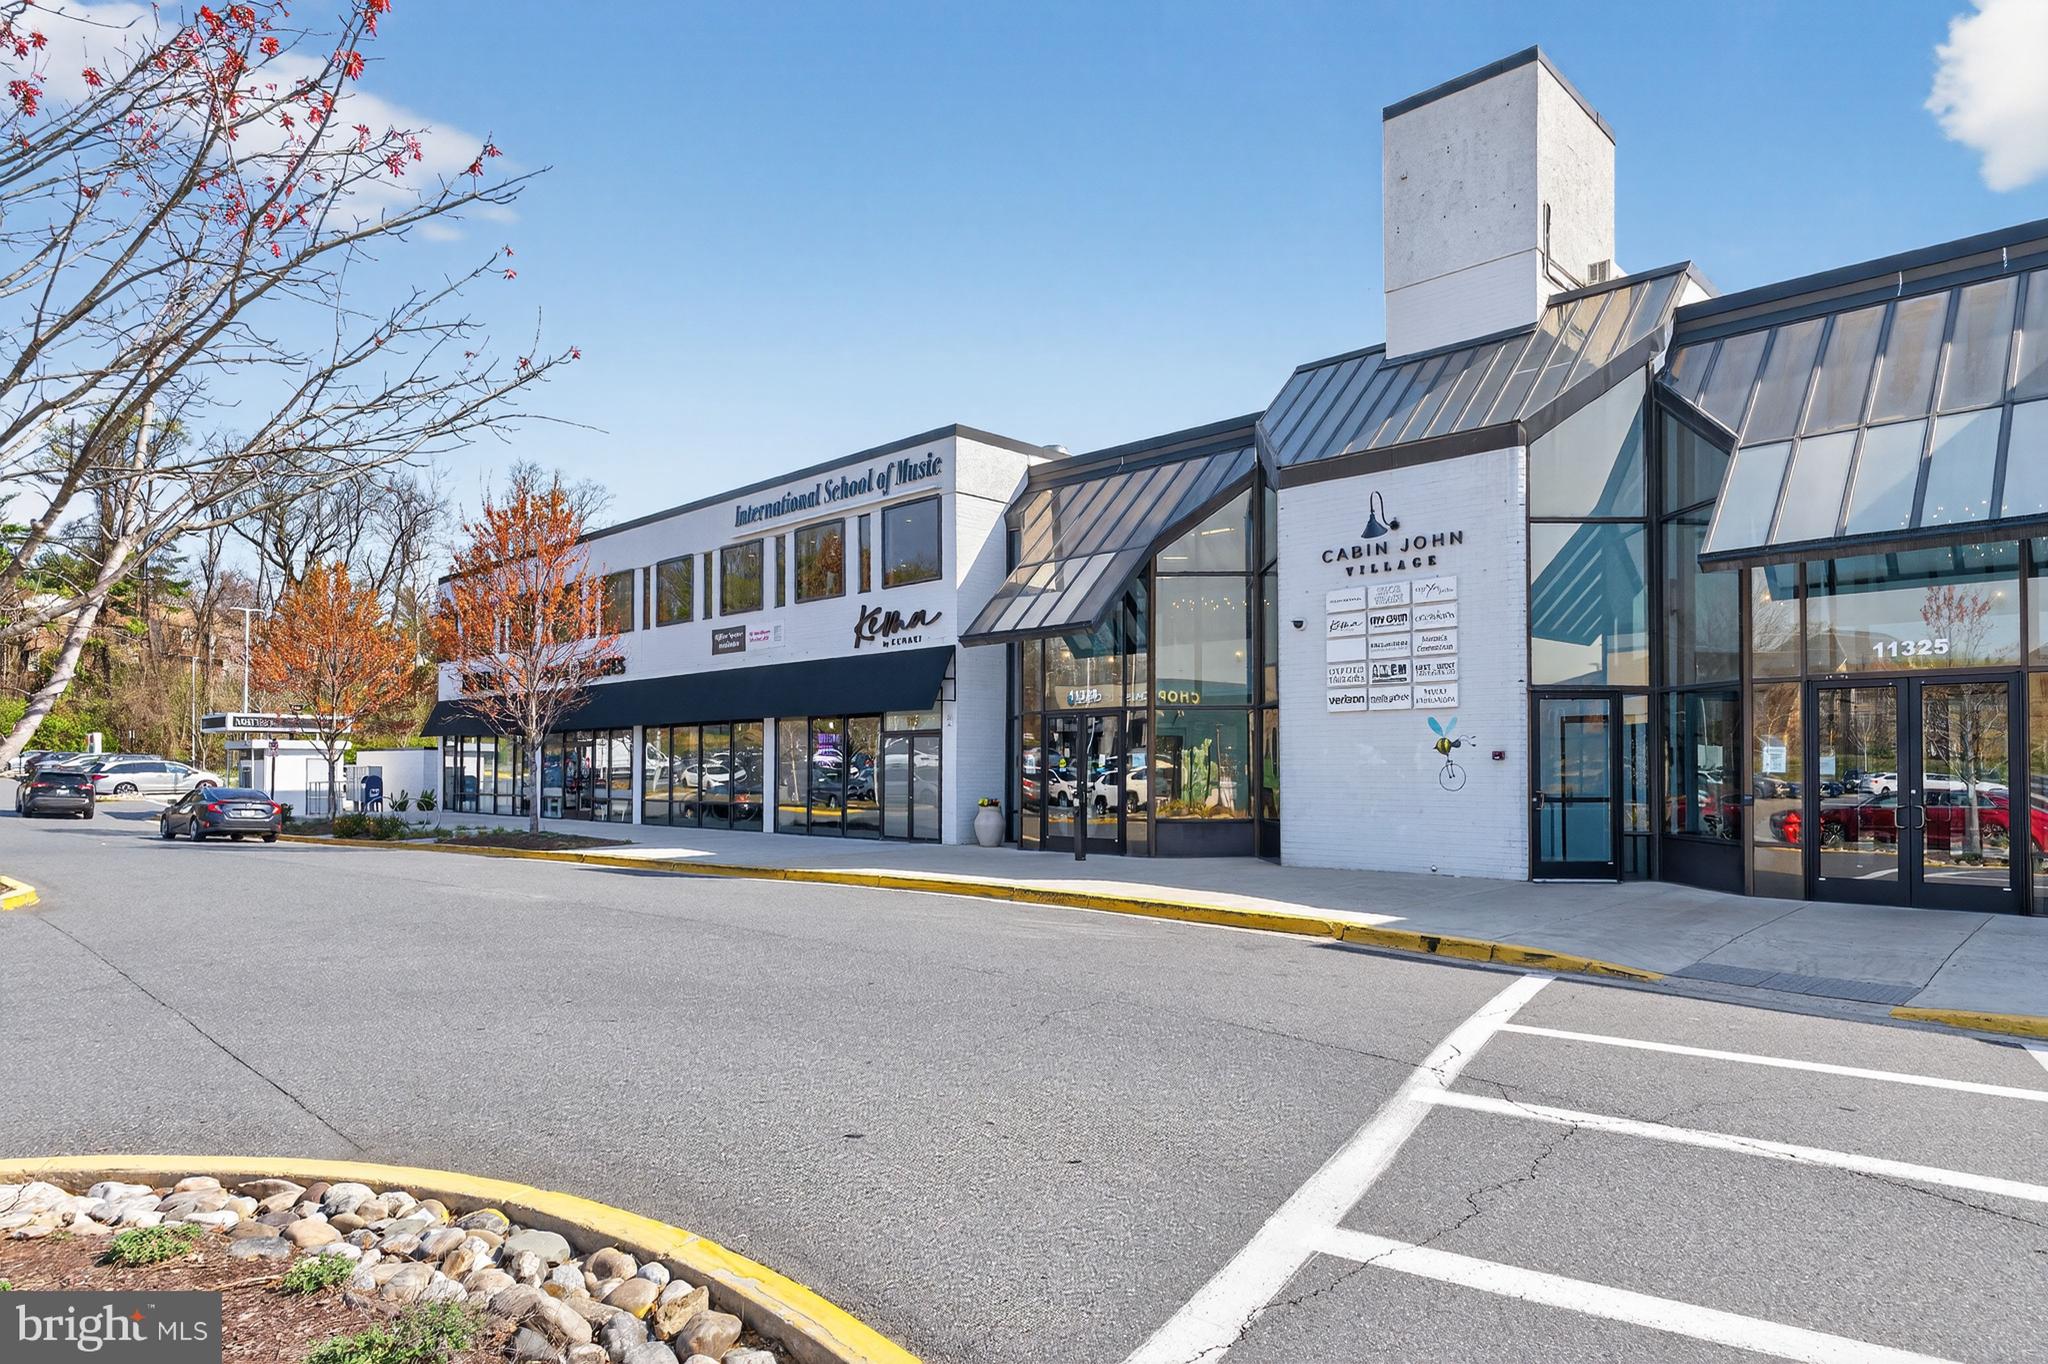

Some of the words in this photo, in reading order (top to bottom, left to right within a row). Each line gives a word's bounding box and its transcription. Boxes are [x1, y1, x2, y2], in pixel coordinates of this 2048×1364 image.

[735, 483, 821, 527] International
[824, 467, 873, 503] School
[877, 462, 896, 496] of
[895, 452, 943, 486] Music
[1322, 541, 1388, 563] CABIN
[1400, 530, 1463, 552] JOHN
[1346, 555, 1437, 576] VILLAGE
[1873, 639, 1949, 658] 11325
[1328, 694, 1365, 704] verizon
